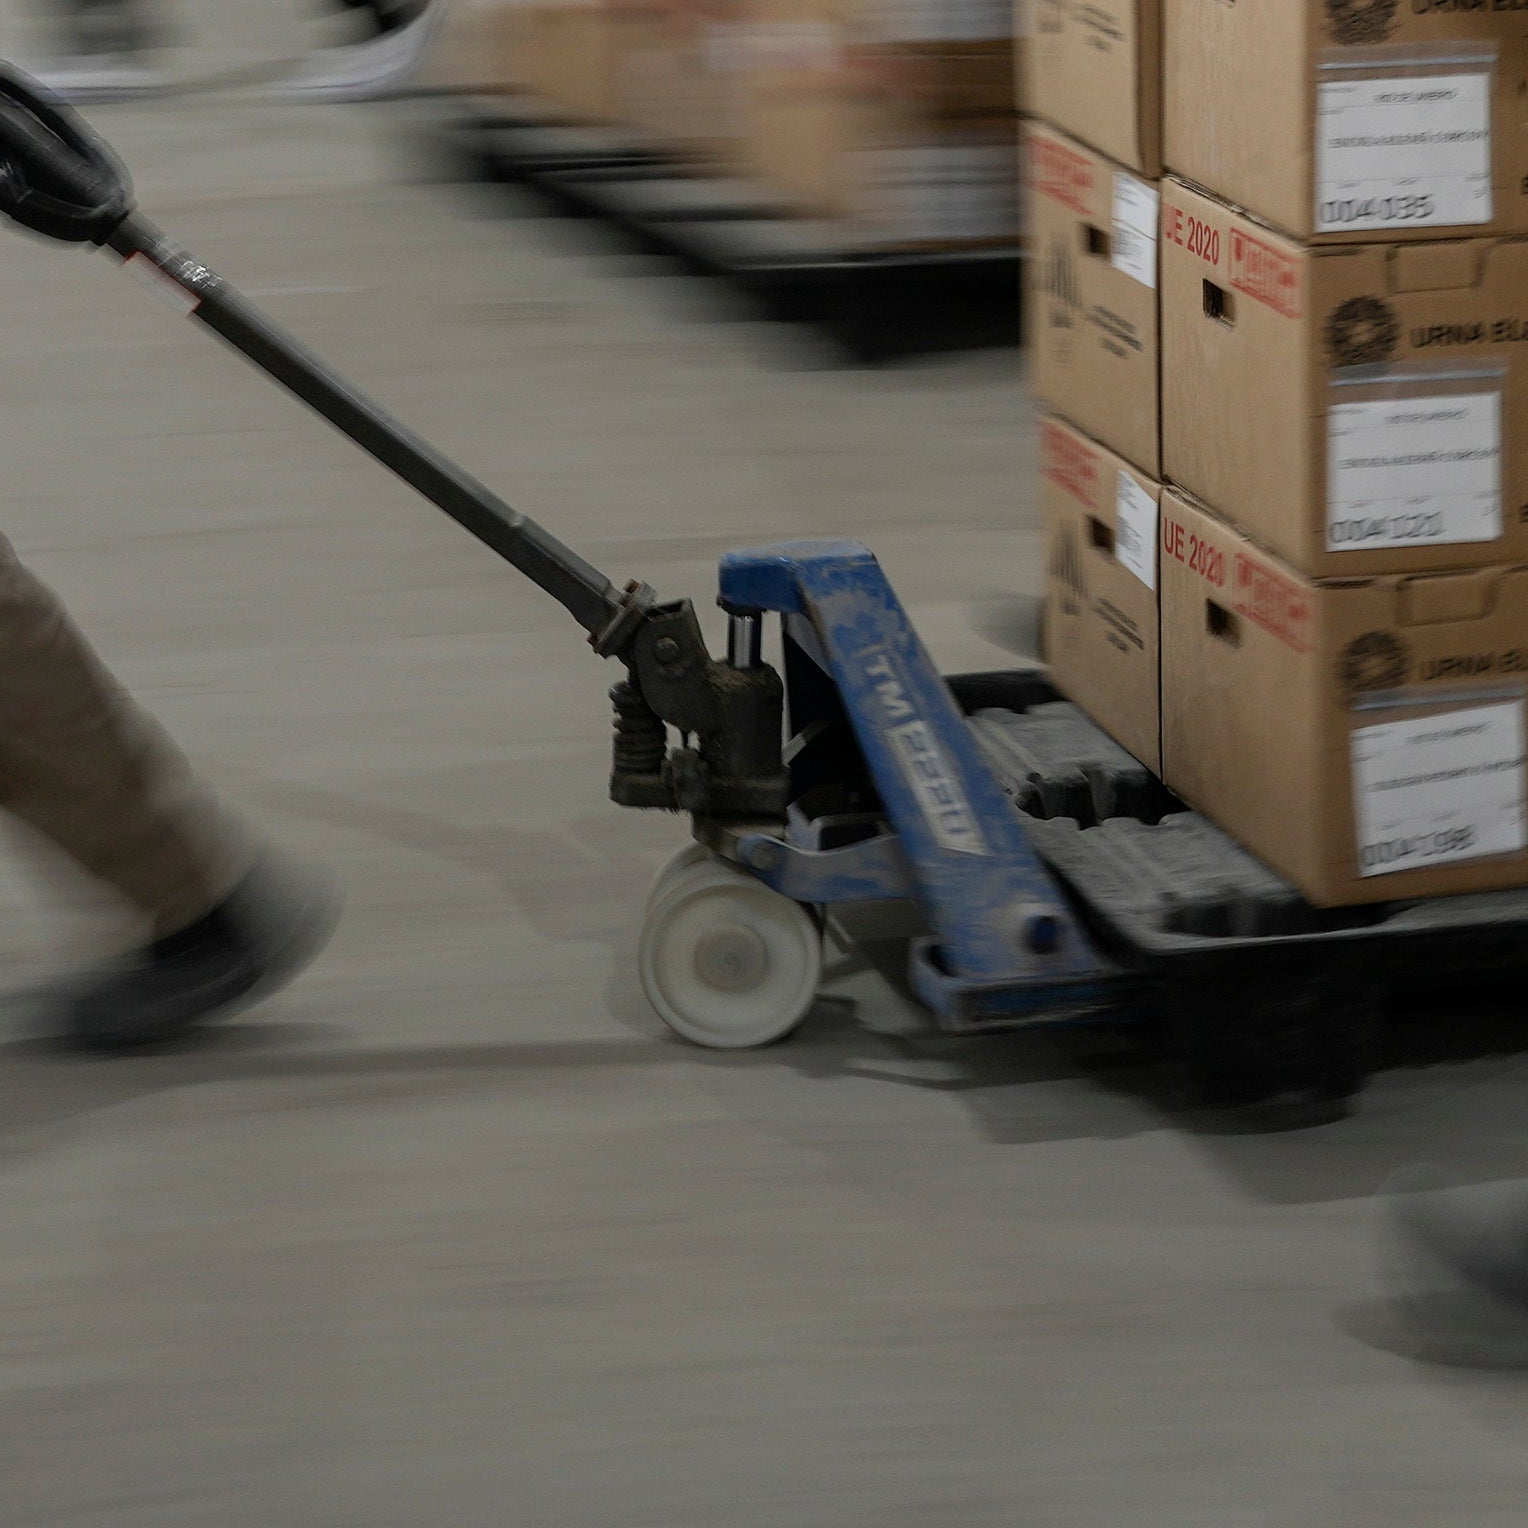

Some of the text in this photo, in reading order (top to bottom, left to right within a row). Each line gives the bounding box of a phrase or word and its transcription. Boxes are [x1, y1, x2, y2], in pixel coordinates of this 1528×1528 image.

[1186, 216, 1220, 266] 2020
[1164, 516, 1226, 588] UE 2020
